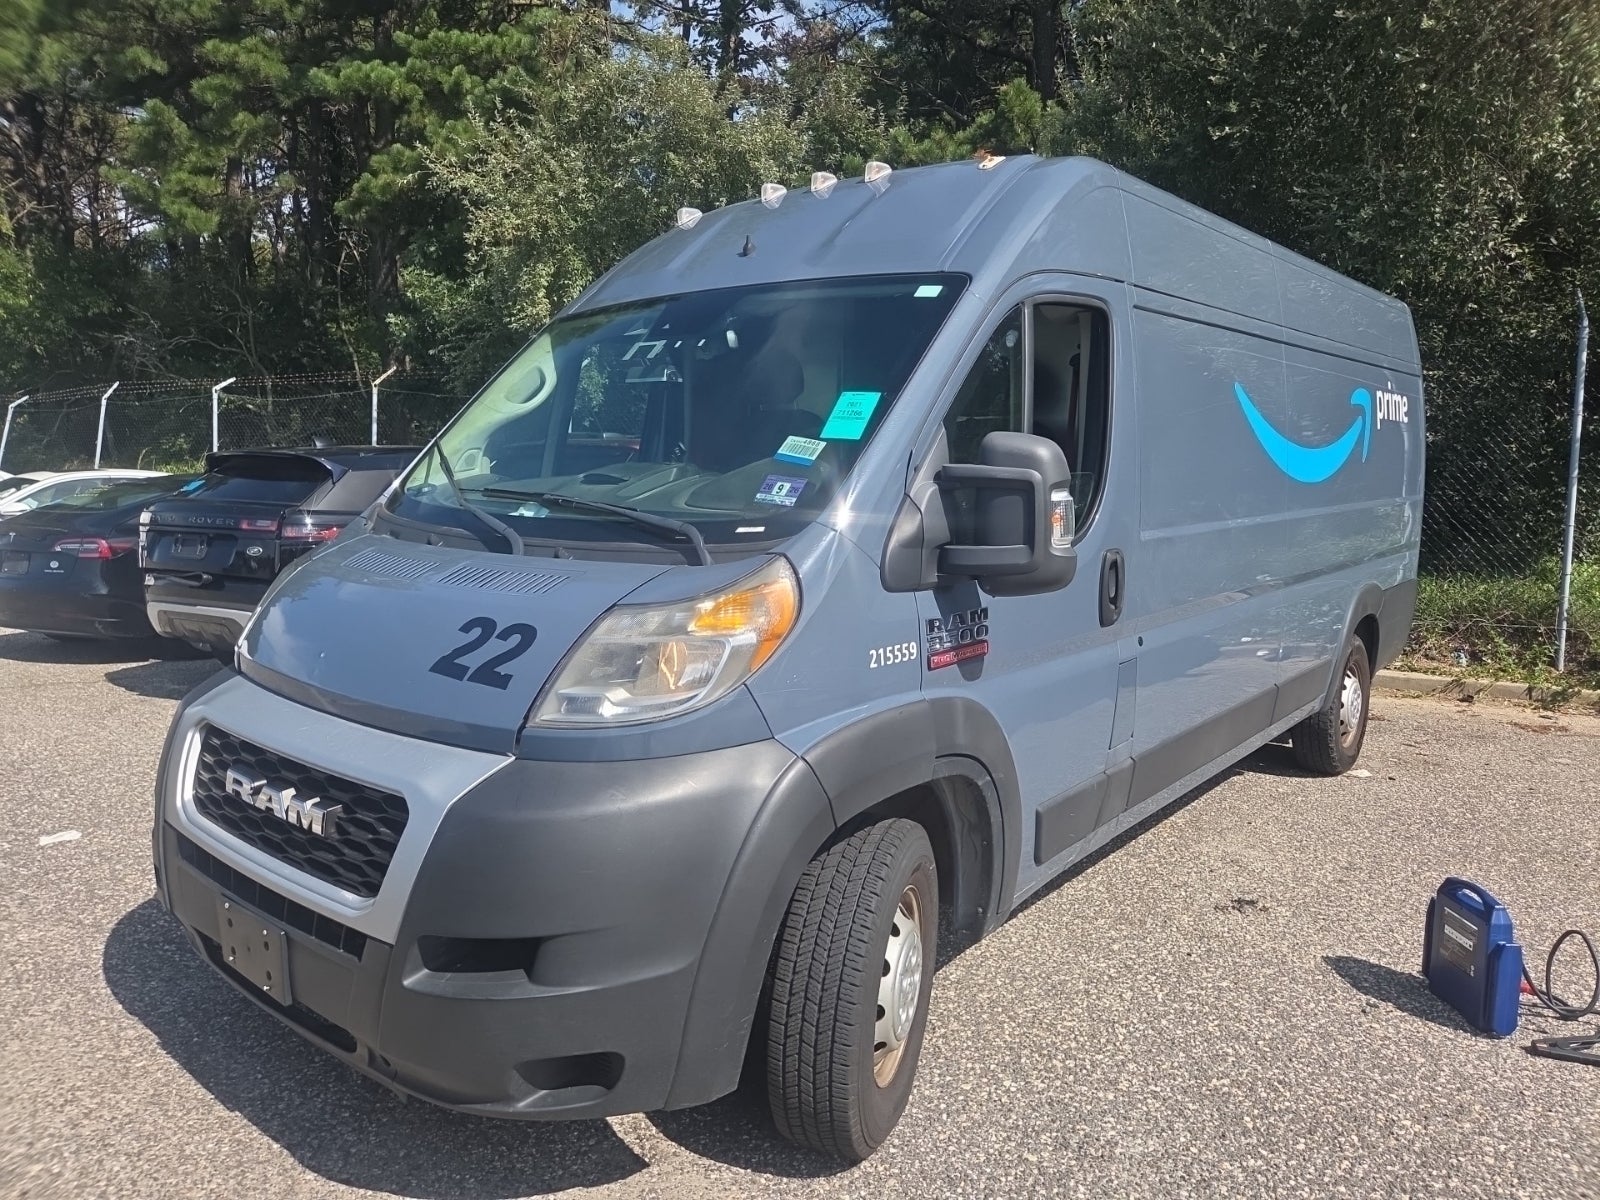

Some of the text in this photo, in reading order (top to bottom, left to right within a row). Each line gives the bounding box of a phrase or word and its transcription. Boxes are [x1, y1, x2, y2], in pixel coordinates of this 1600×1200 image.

[1376, 381, 1409, 430] prime
[776, 484, 784, 494] 9
[188, 515, 234, 526] ROVER
[925, 607, 988, 637] RAM
[926, 624, 989, 653] 3500
[428, 616, 538, 691] 22
[869, 641, 918, 669] 215559
[225, 764, 343, 838] RAM
